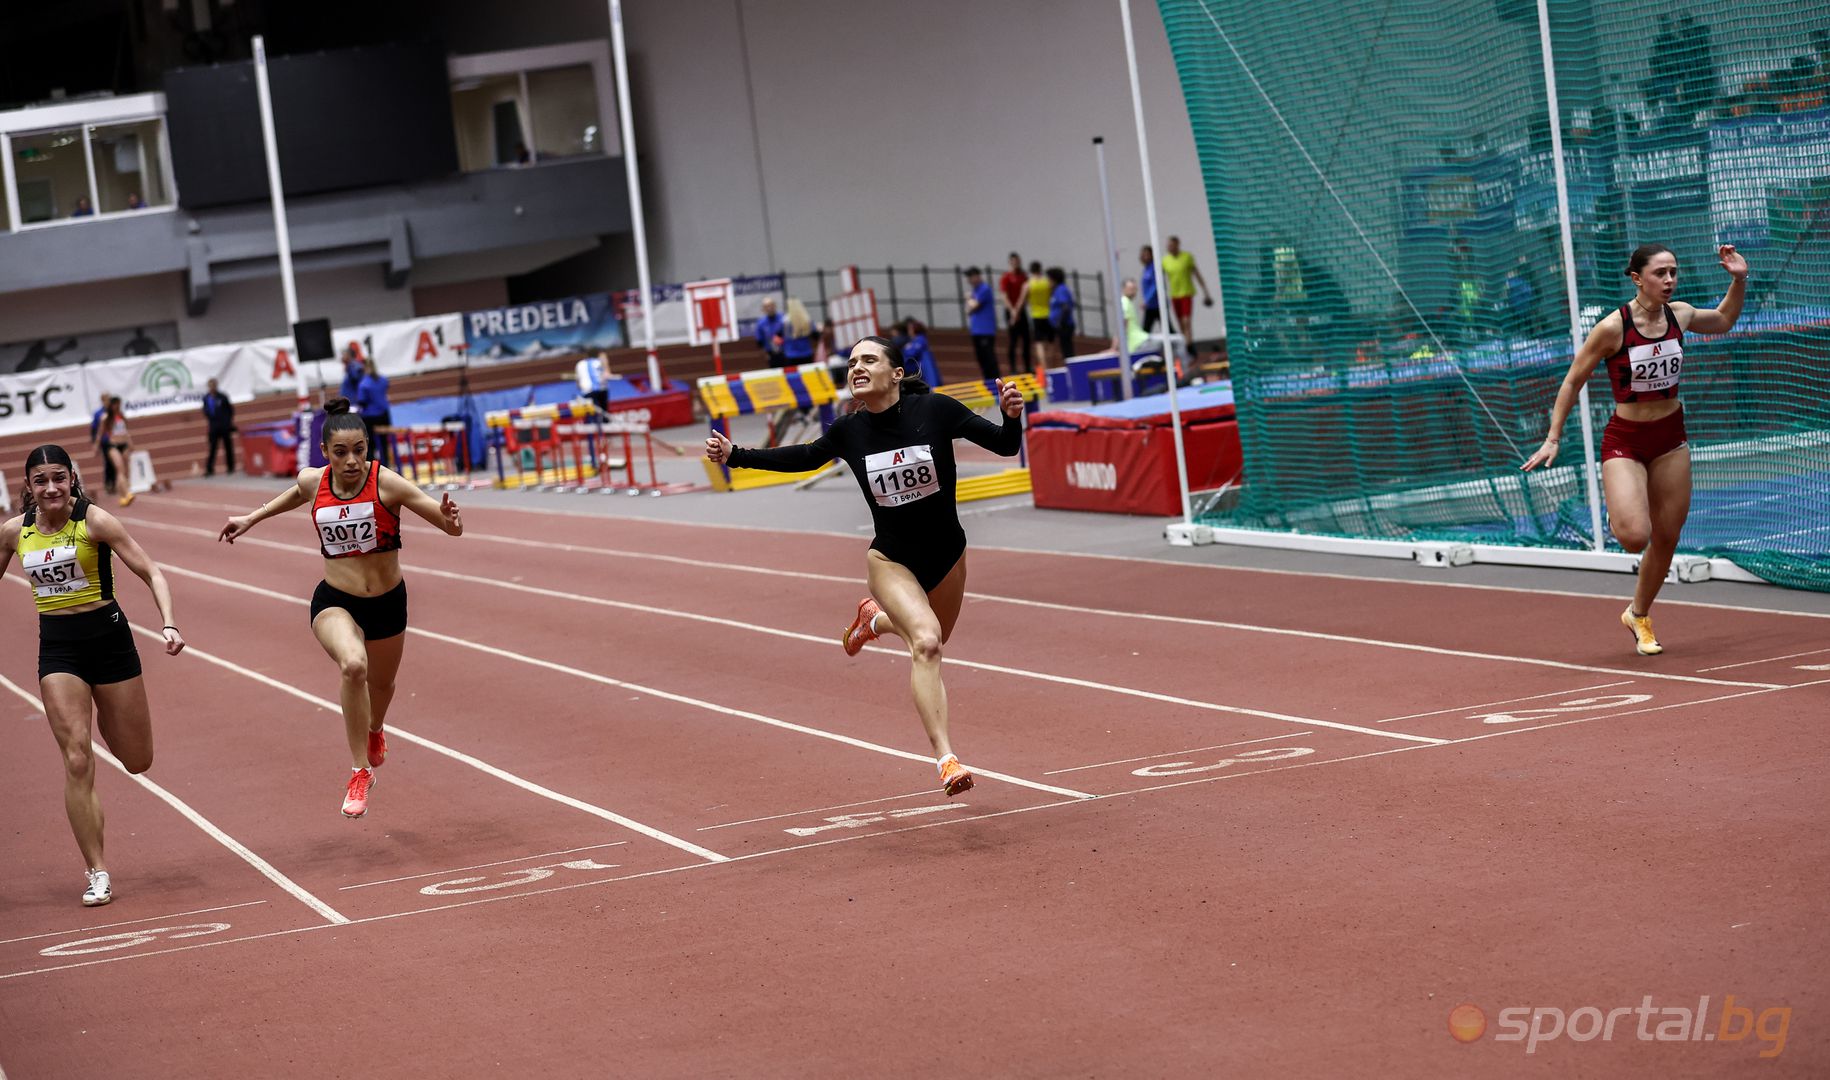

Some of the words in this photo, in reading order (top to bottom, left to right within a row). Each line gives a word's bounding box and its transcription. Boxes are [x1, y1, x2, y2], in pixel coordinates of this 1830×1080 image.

[470, 299, 590, 338] PREDELA
[414, 325, 444, 362] A1
[1652, 344, 1662, 356] A1
[1635, 357, 1679, 379] 2218
[893, 449, 905, 465] A1
[874, 465, 932, 494] 1188
[900, 490, 922, 502] БФЛА
[339, 505, 350, 520] A1
[323, 521, 373, 542] 3072
[44, 548, 55, 563] A1
[30, 562, 76, 584] 1557
[1131, 746, 1316, 777] 3
[783, 802, 970, 837] 4
[38, 922, 232, 957] 6
